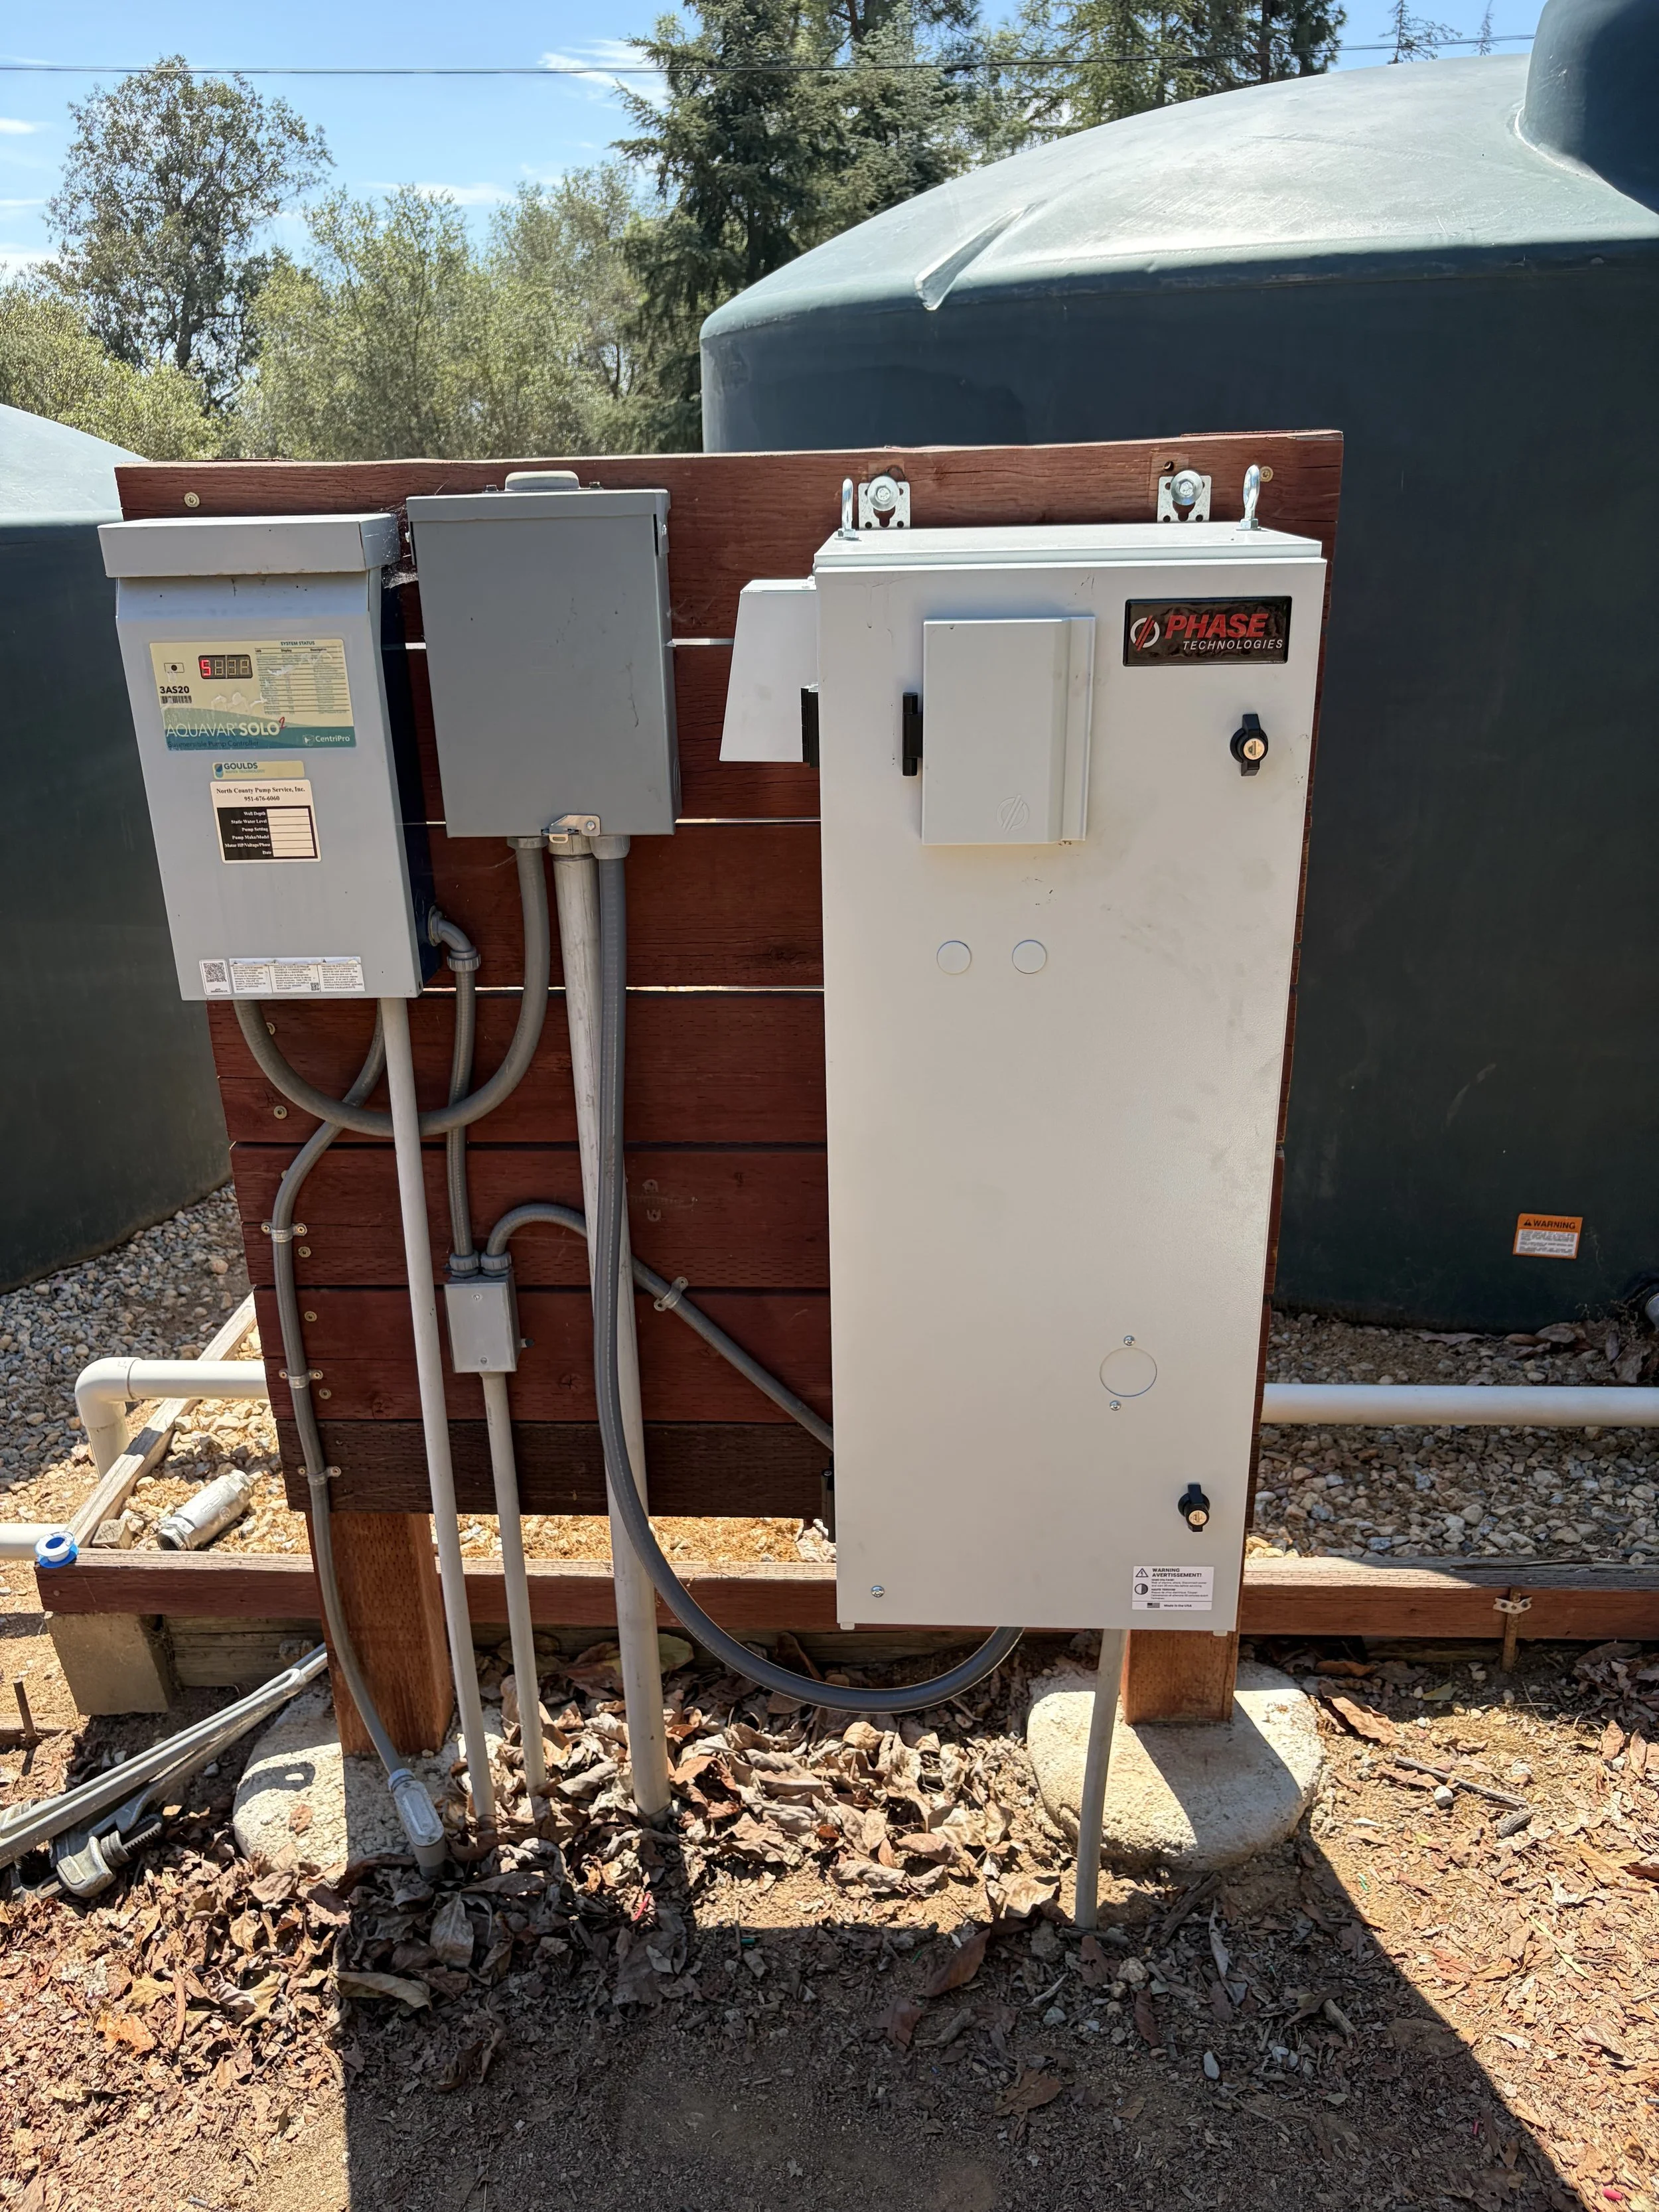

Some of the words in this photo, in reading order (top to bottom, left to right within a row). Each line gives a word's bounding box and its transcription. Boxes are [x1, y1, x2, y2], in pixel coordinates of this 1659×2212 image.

[1165, 613, 1269, 639] PHASE
[1183, 639, 1283, 650] TECHNOLOGIES
[166, 723, 236, 737] AQUAVAR
[238, 721, 280, 736] SOLO
[1533, 1220, 1576, 1229] WARNING
